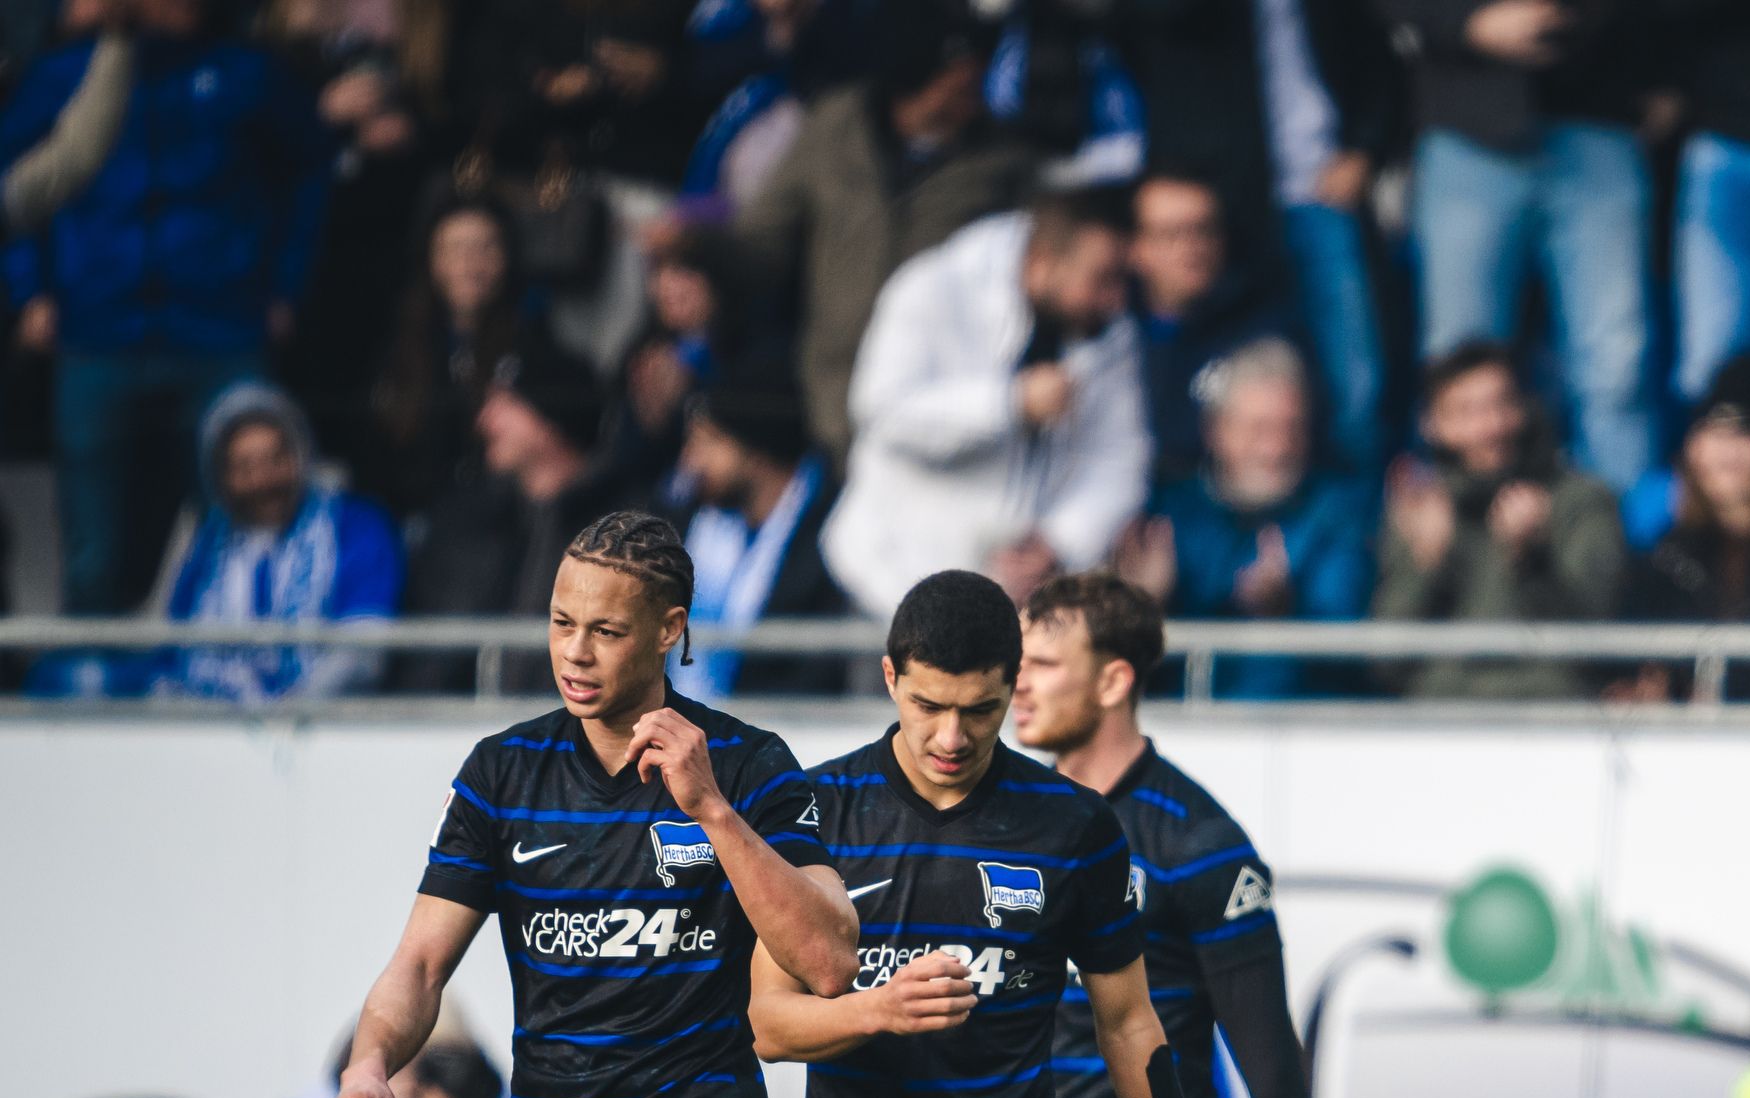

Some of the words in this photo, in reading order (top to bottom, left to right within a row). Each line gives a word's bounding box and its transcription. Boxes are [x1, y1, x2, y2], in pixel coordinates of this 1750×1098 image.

[664, 847, 695, 862] Hertha
[993, 889, 1024, 905] Hertha
[1024, 890, 1041, 906] BSC
[541, 908, 610, 934] check
[535, 930, 599, 957] CARS
